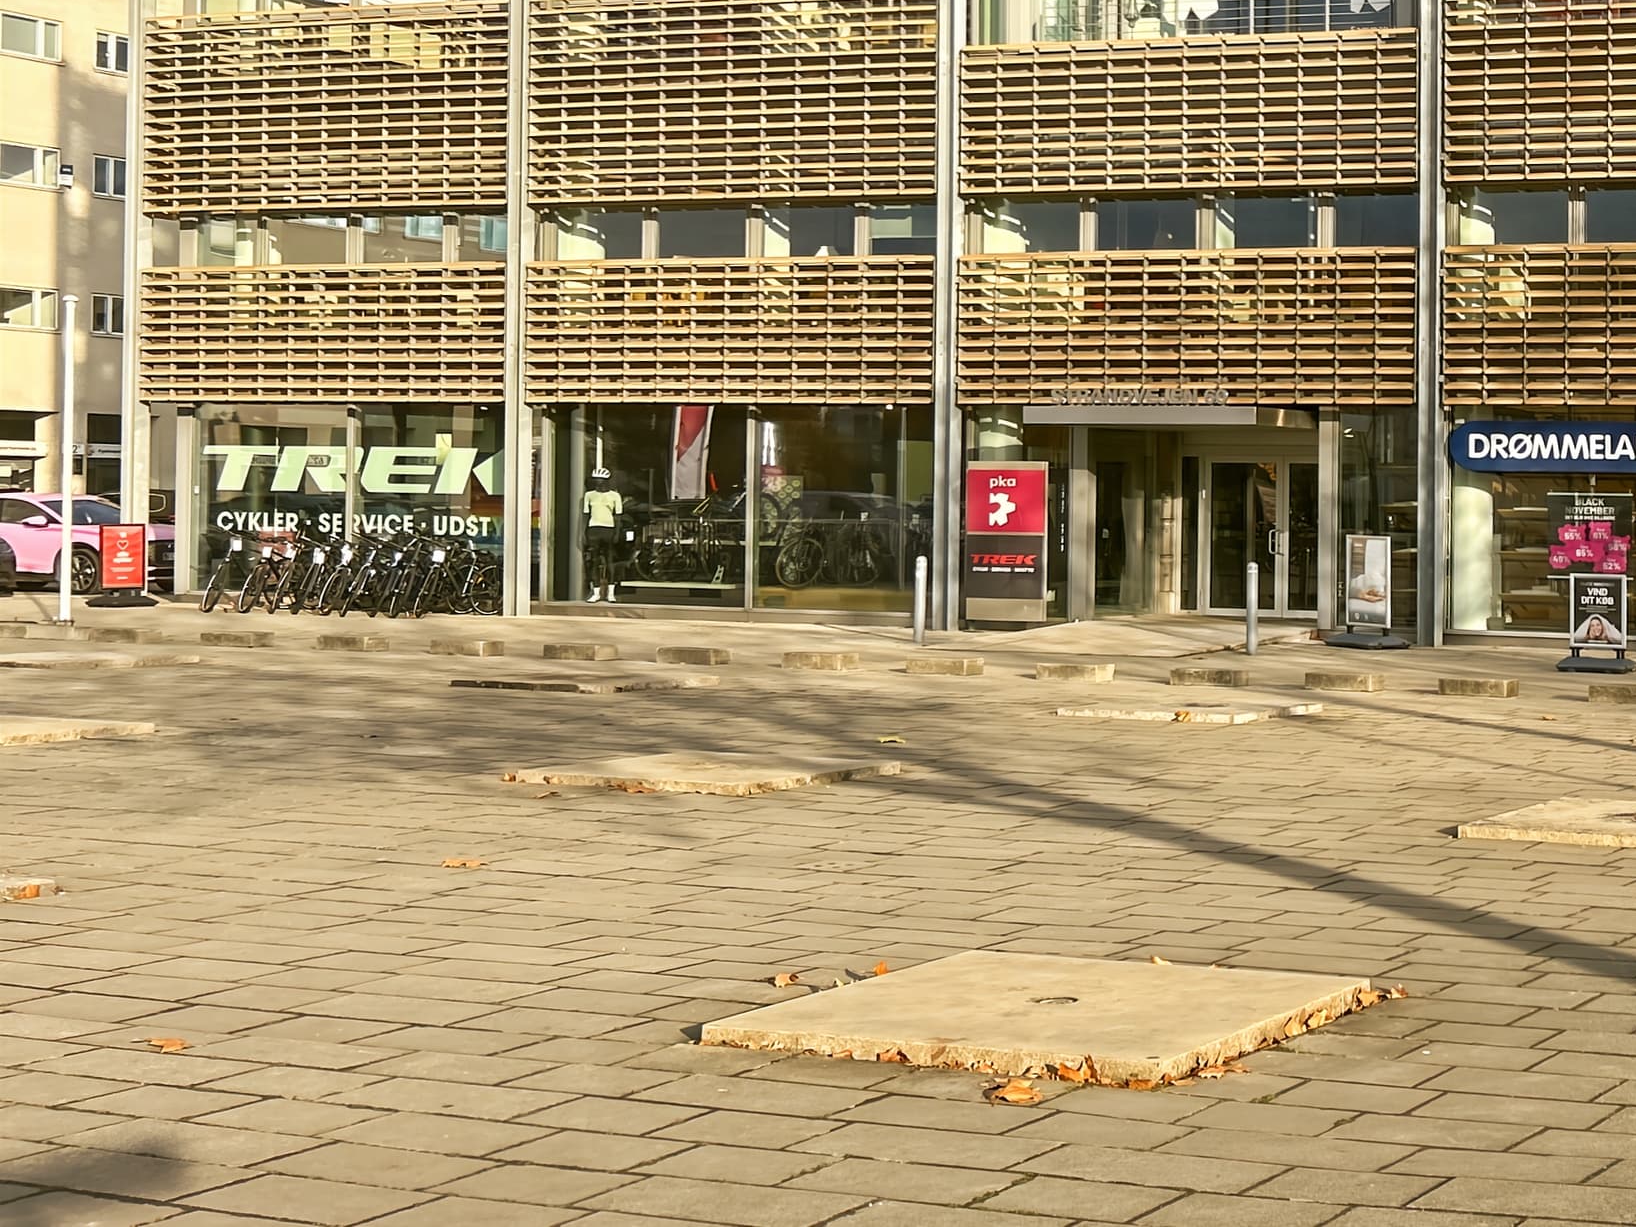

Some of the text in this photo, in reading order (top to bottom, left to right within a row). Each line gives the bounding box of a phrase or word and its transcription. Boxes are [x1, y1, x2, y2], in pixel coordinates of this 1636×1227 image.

[202, 445, 504, 495] TREK
[989, 475, 1017, 489] pka
[217, 511, 299, 532] CYKLER
[970, 553, 1037, 565] TREK
[1587, 587, 1608, 596] VIND
[1581, 596, 1595, 605] DIT
